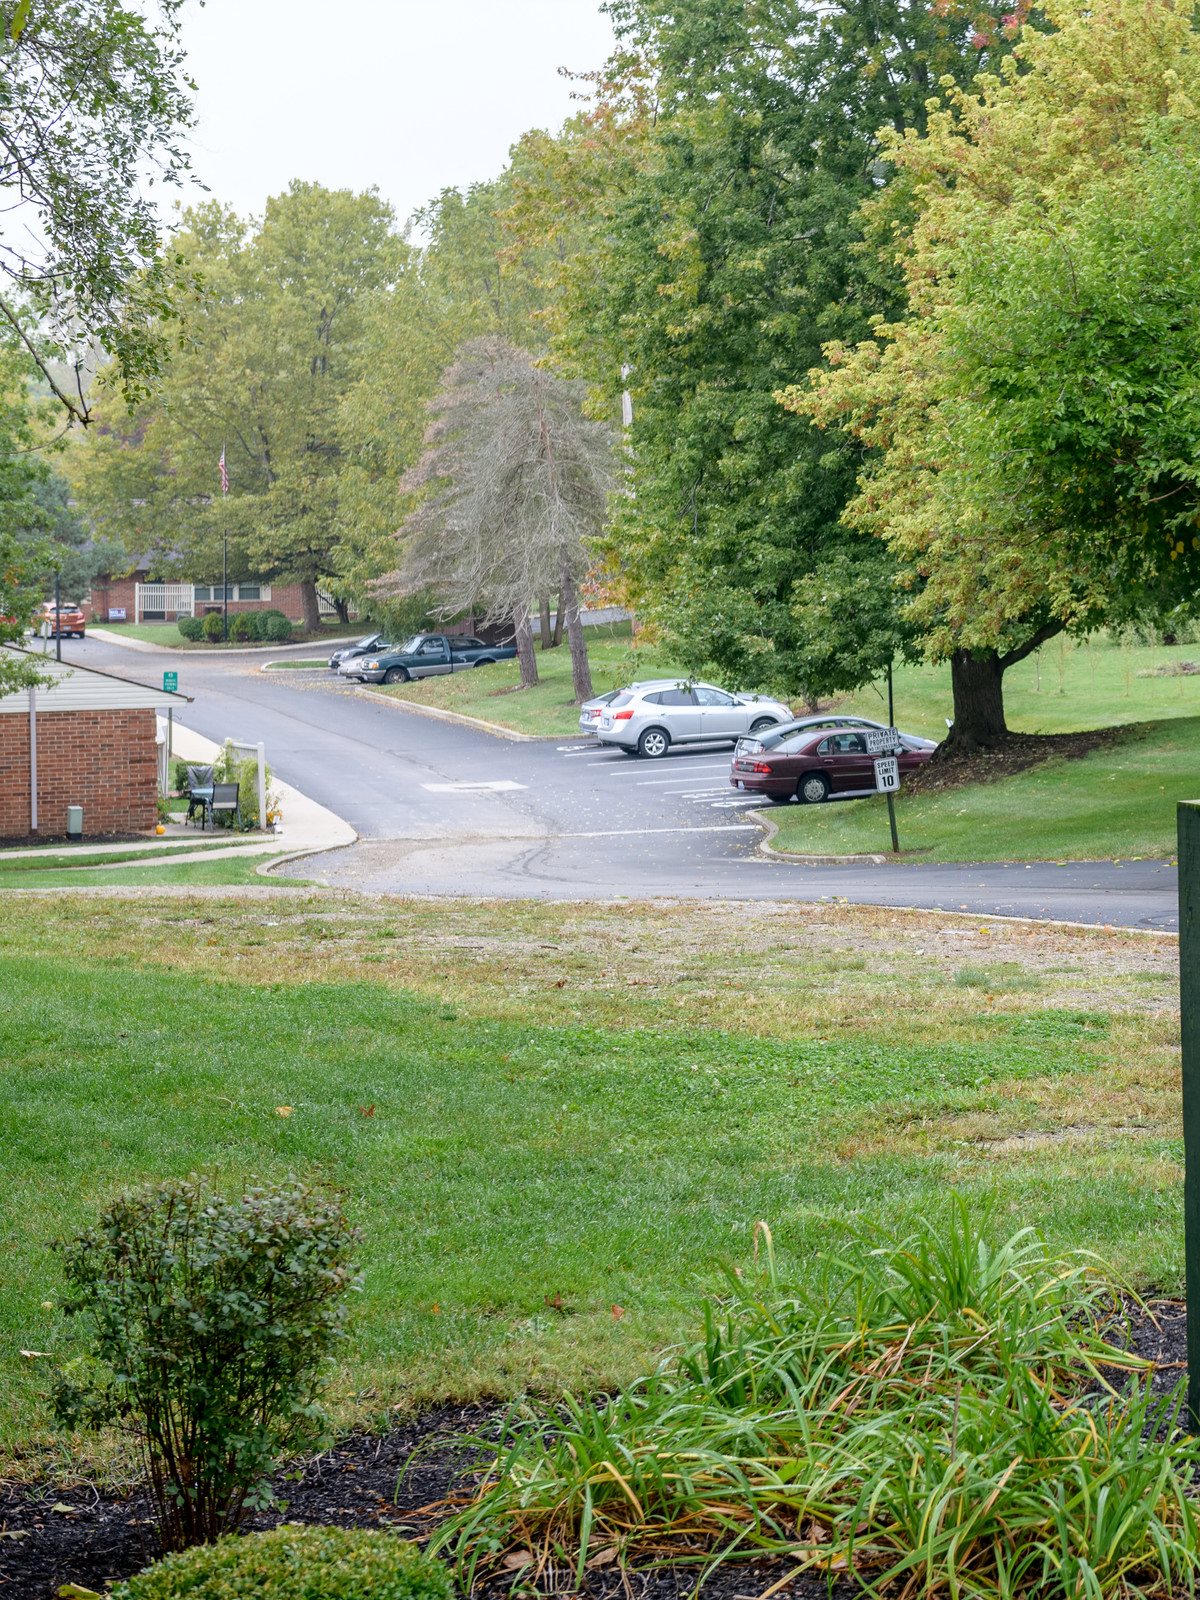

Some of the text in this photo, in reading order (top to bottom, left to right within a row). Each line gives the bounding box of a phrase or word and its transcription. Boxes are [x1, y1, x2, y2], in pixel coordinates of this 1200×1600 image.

[868, 730, 896, 740] PRIVATE
[869, 737, 896, 747] PROPERTY
[877, 761, 895, 769] SPEED
[878, 767, 895, 776] LIMIT
[882, 775, 894, 787] 10
